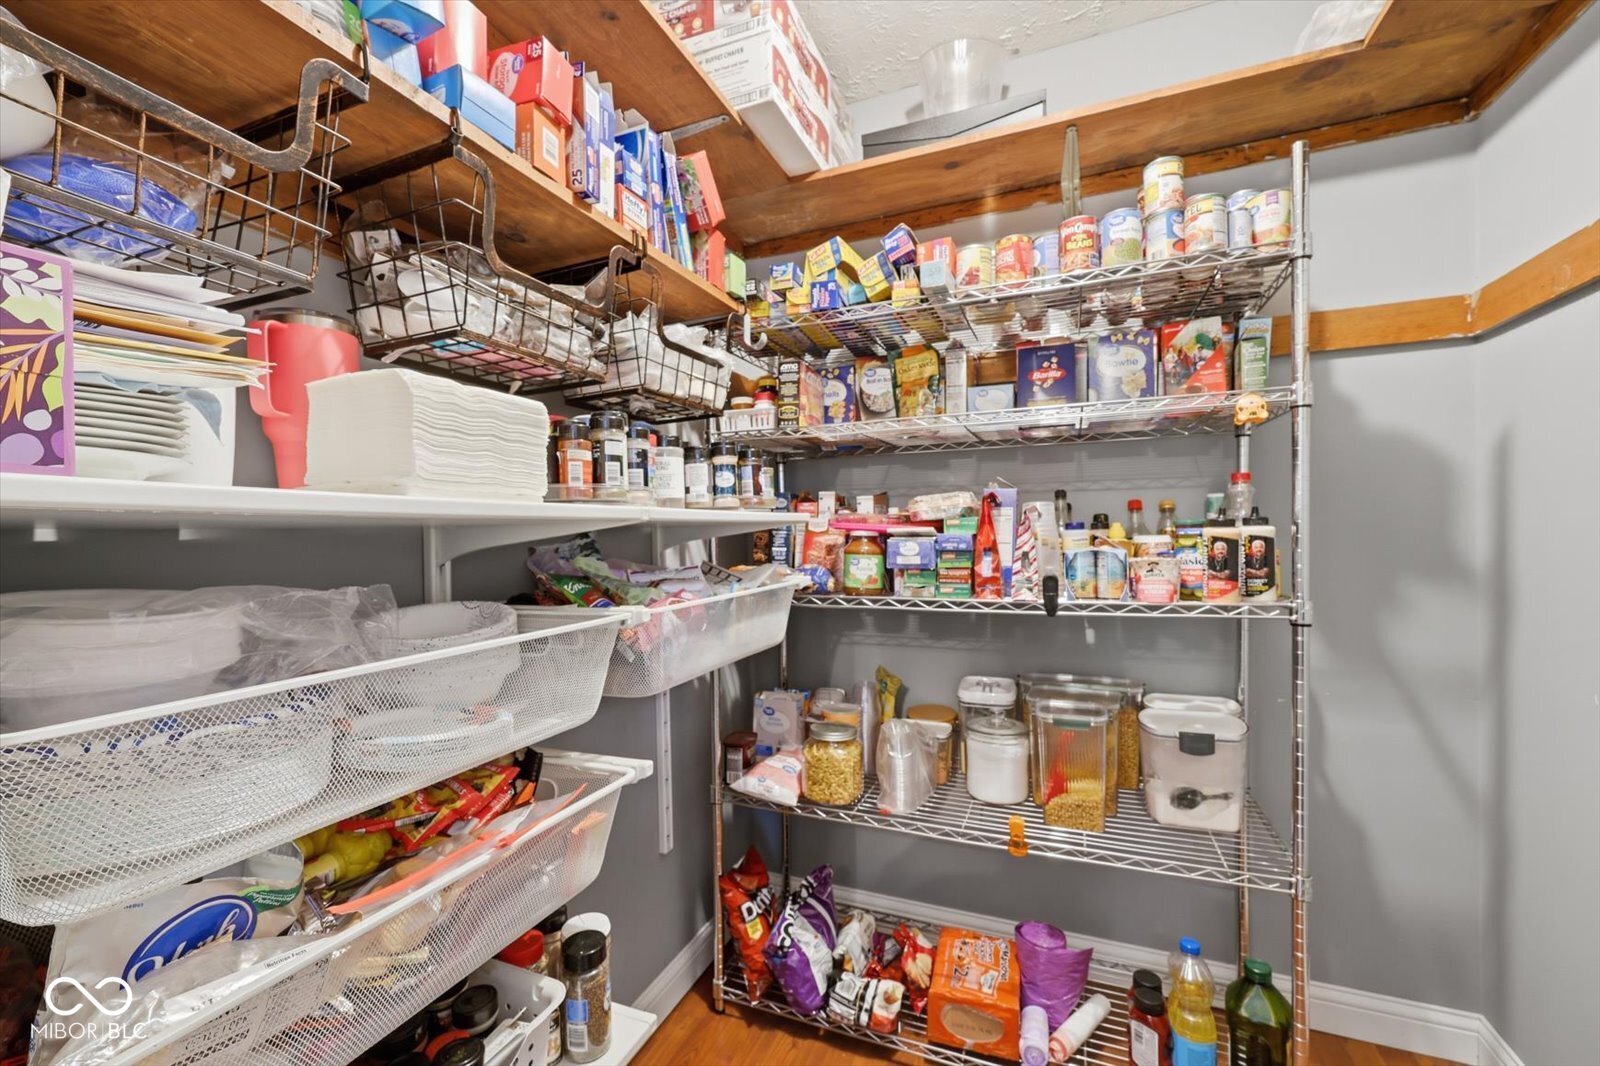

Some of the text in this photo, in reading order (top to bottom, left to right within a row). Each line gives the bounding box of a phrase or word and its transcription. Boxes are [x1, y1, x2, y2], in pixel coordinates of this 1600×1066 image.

[532, 41, 542, 58] 25
[724, 47, 744, 59] CHAFER
[572, 168, 583, 186] 25
[1066, 238, 1094, 251] BEANS
[1032, 370, 1063, 380] Barilla
[265, 954, 292, 969] Nutrition
